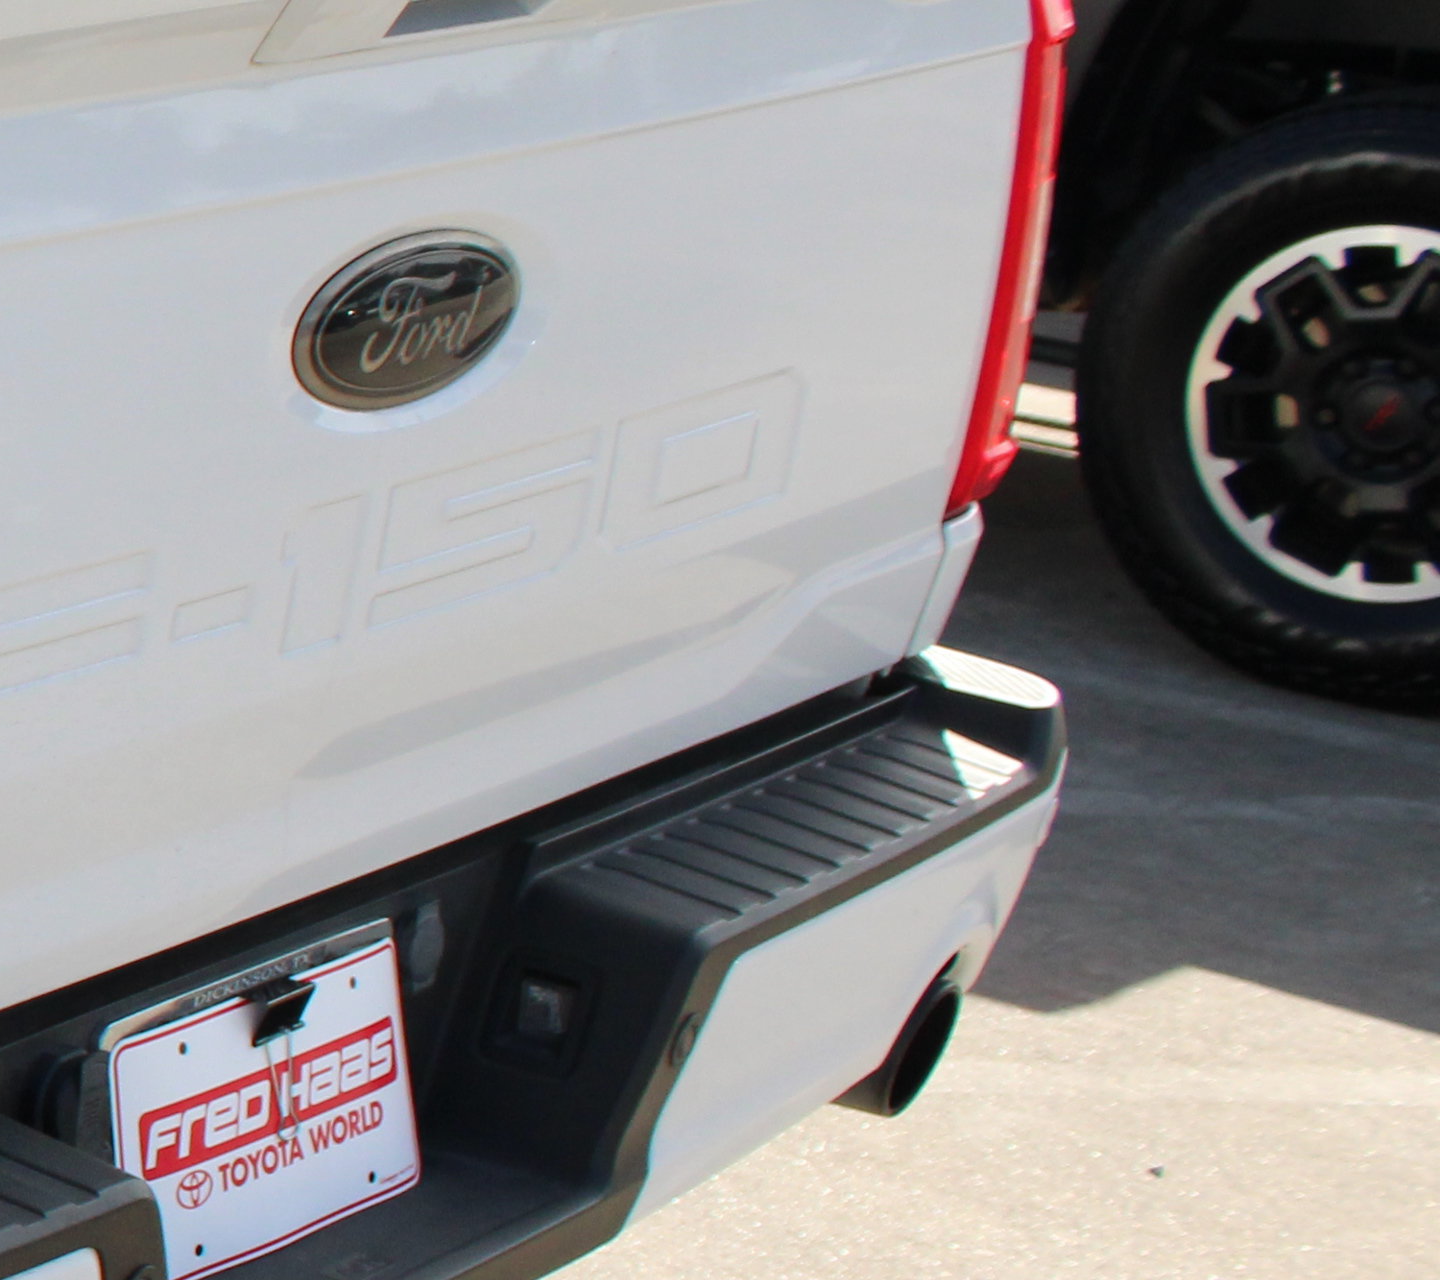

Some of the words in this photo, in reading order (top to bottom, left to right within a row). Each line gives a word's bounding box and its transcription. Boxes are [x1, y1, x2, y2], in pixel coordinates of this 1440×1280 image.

[360, 270, 489, 375] Ford
[218, 1135, 304, 1192] TOYOTA
[308, 1100, 384, 1154] WORLD
